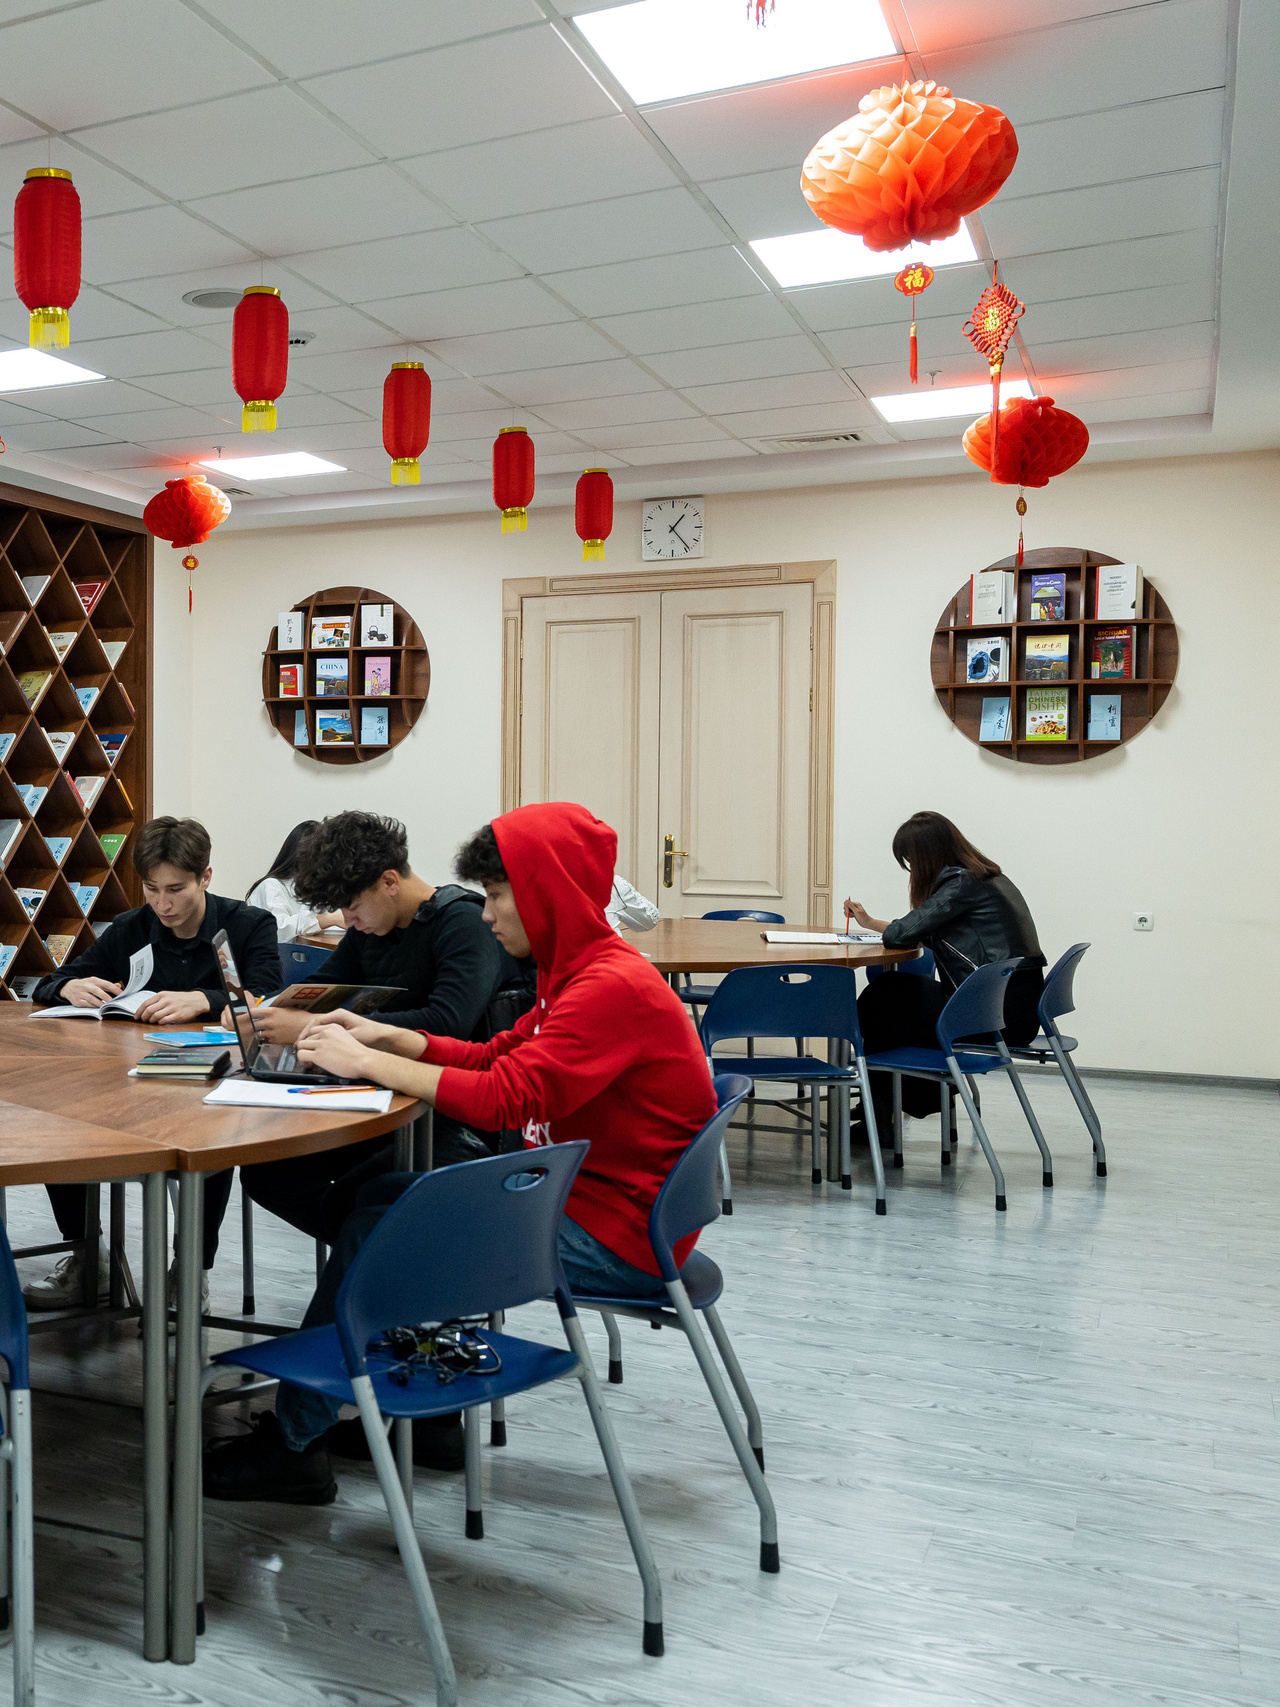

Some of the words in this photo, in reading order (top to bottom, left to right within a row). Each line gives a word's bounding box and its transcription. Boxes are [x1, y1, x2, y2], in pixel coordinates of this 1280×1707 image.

[903, 269, 925, 289] 福
[1097, 629, 1128, 637] SICHUAN
[1028, 702, 1066, 711] DISHES
